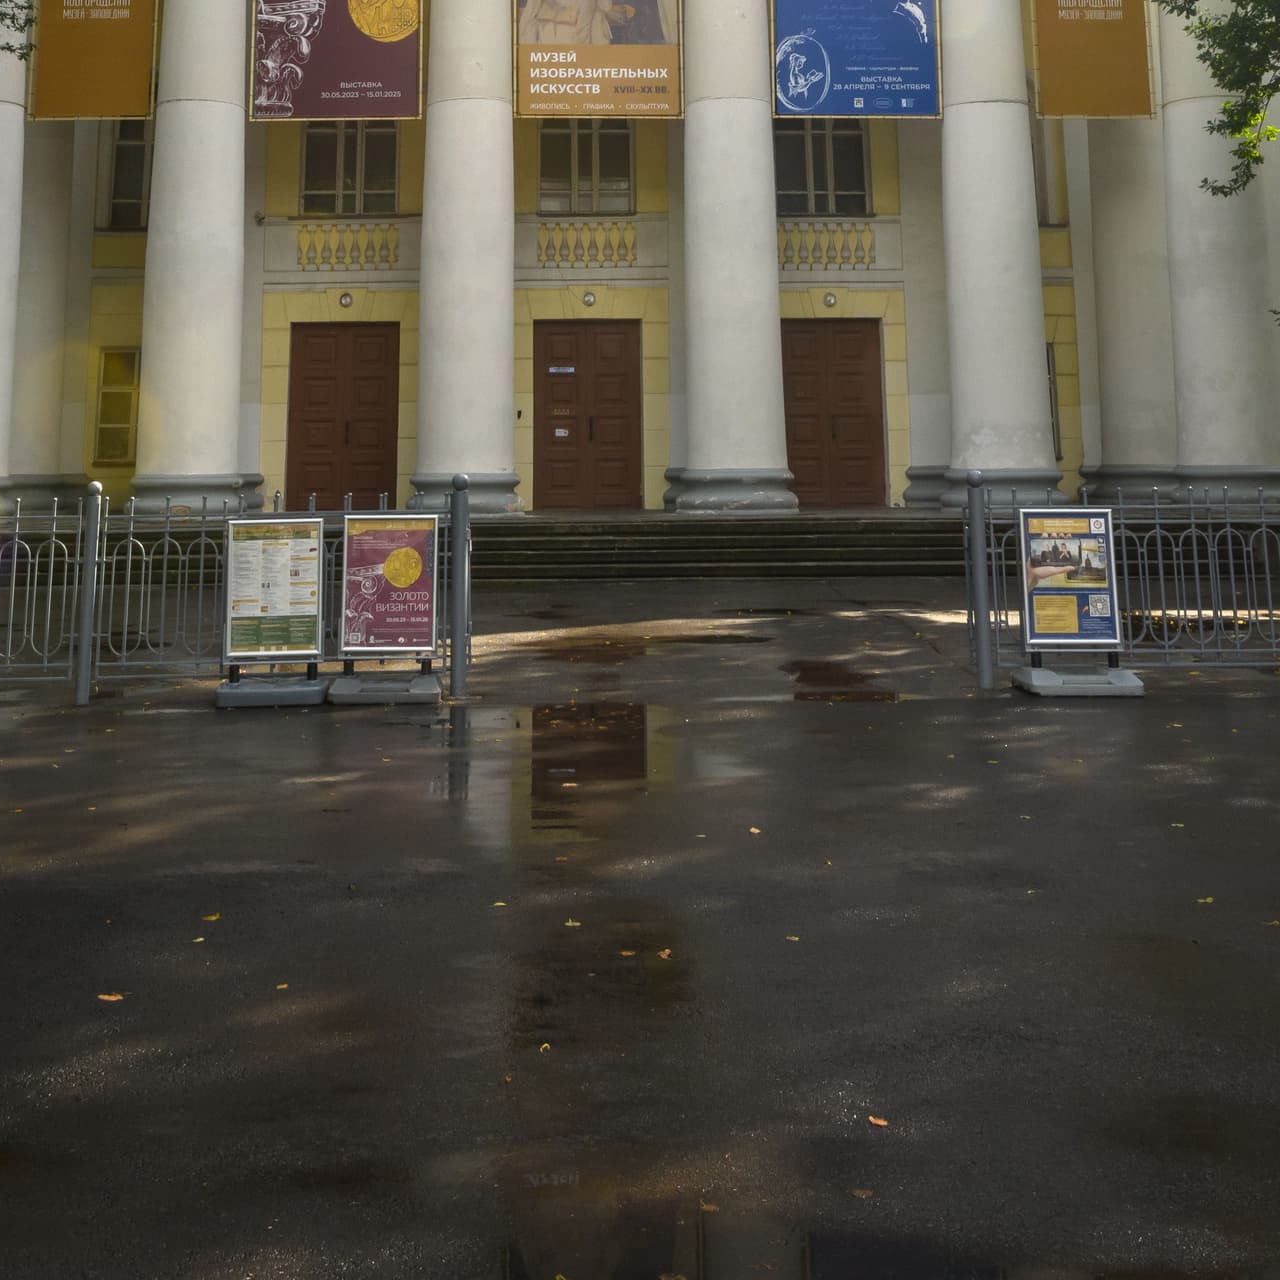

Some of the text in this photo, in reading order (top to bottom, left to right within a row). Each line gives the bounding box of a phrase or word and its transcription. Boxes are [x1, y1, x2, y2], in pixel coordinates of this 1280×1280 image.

[530, 50, 577, 63] МУЗЕЙ
[530, 67, 668, 79] ИЗОБРАЗИТЕЛЬНЫХ
[340, 81, 383, 89] ВЫСТАВКА
[530, 83, 601, 94] ИСКУССТВ
